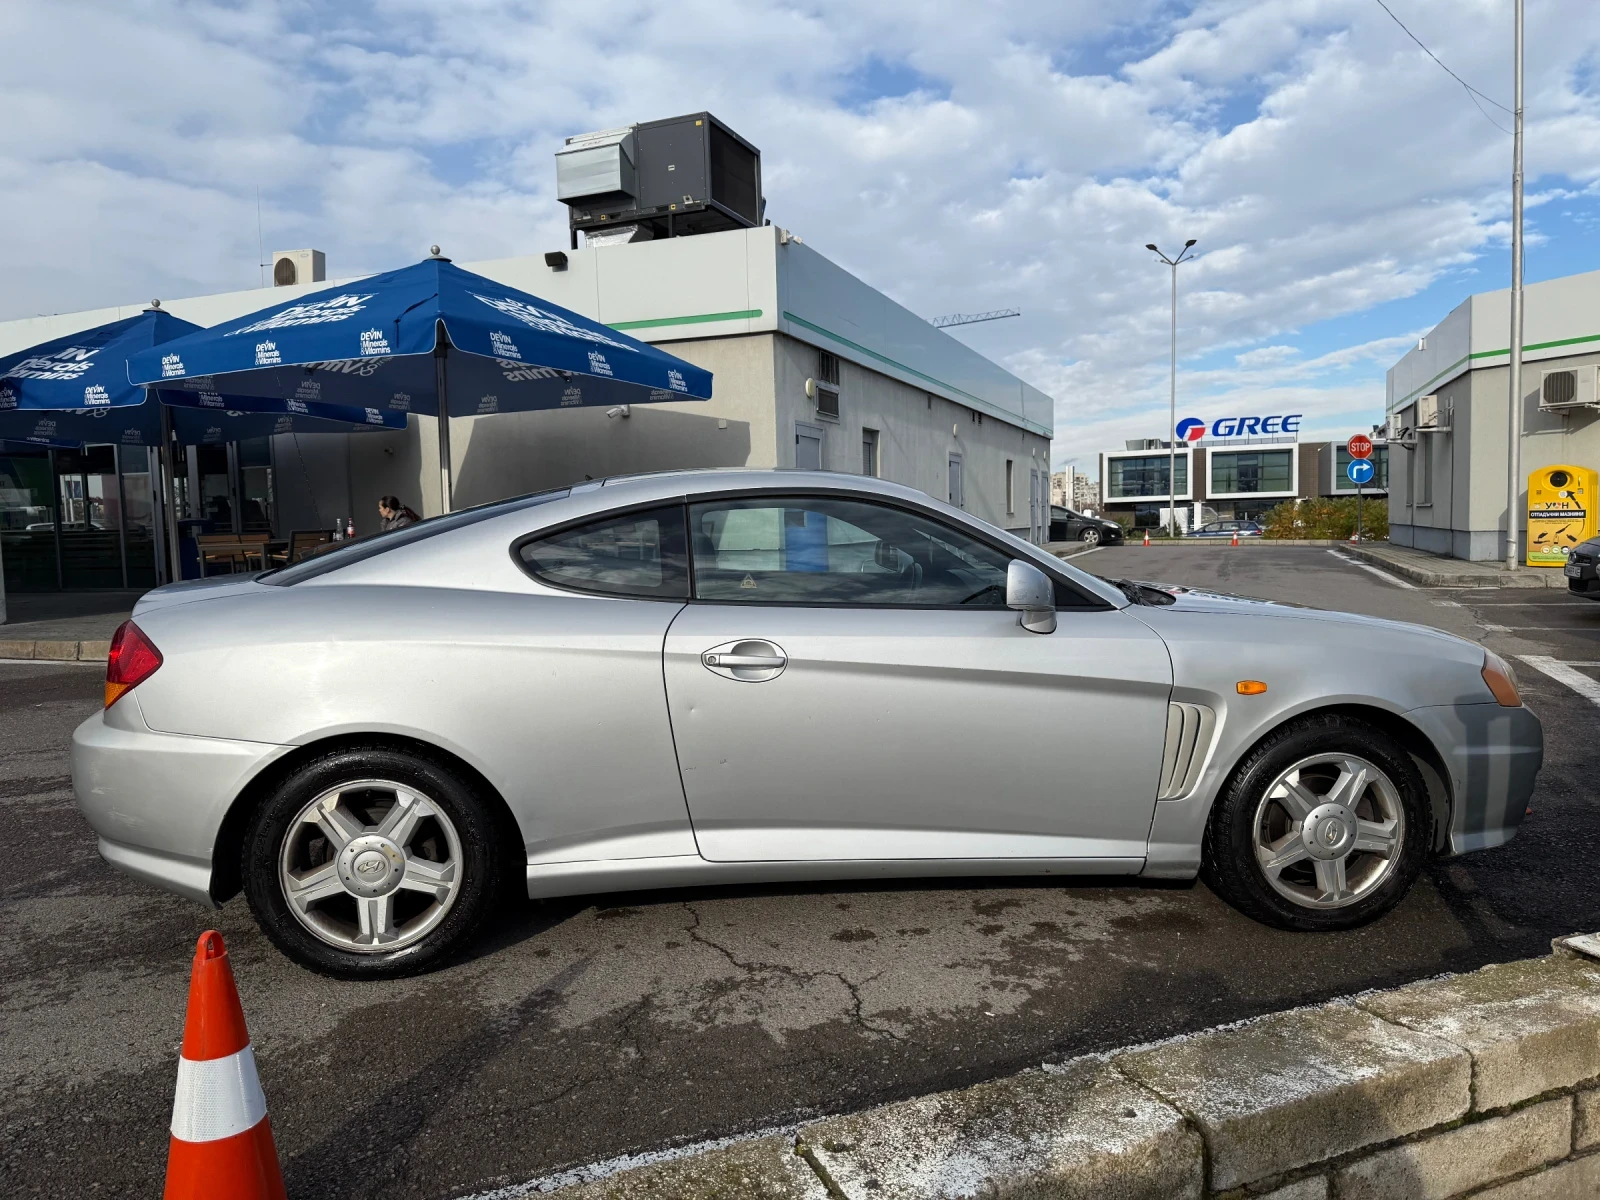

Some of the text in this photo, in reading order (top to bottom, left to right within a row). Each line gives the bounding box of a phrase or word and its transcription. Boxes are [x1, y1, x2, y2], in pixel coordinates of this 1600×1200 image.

[360, 331, 382, 340] DEVIN
[490, 332, 512, 344] DEVIN
[256, 342, 276, 351] DEVIN
[362, 339, 388, 347] Minerals
[494, 342, 518, 352] Minerals
[162, 355, 180, 364] DEVIN
[588, 352, 606, 361] DEVIN
[164, 362, 184, 370] Minerals
[591, 360, 610, 370] Minerals
[668, 370, 682, 380] DEVIN
[1212, 414, 1302, 437] GREE
[1351, 442, 1370, 452] STOP
